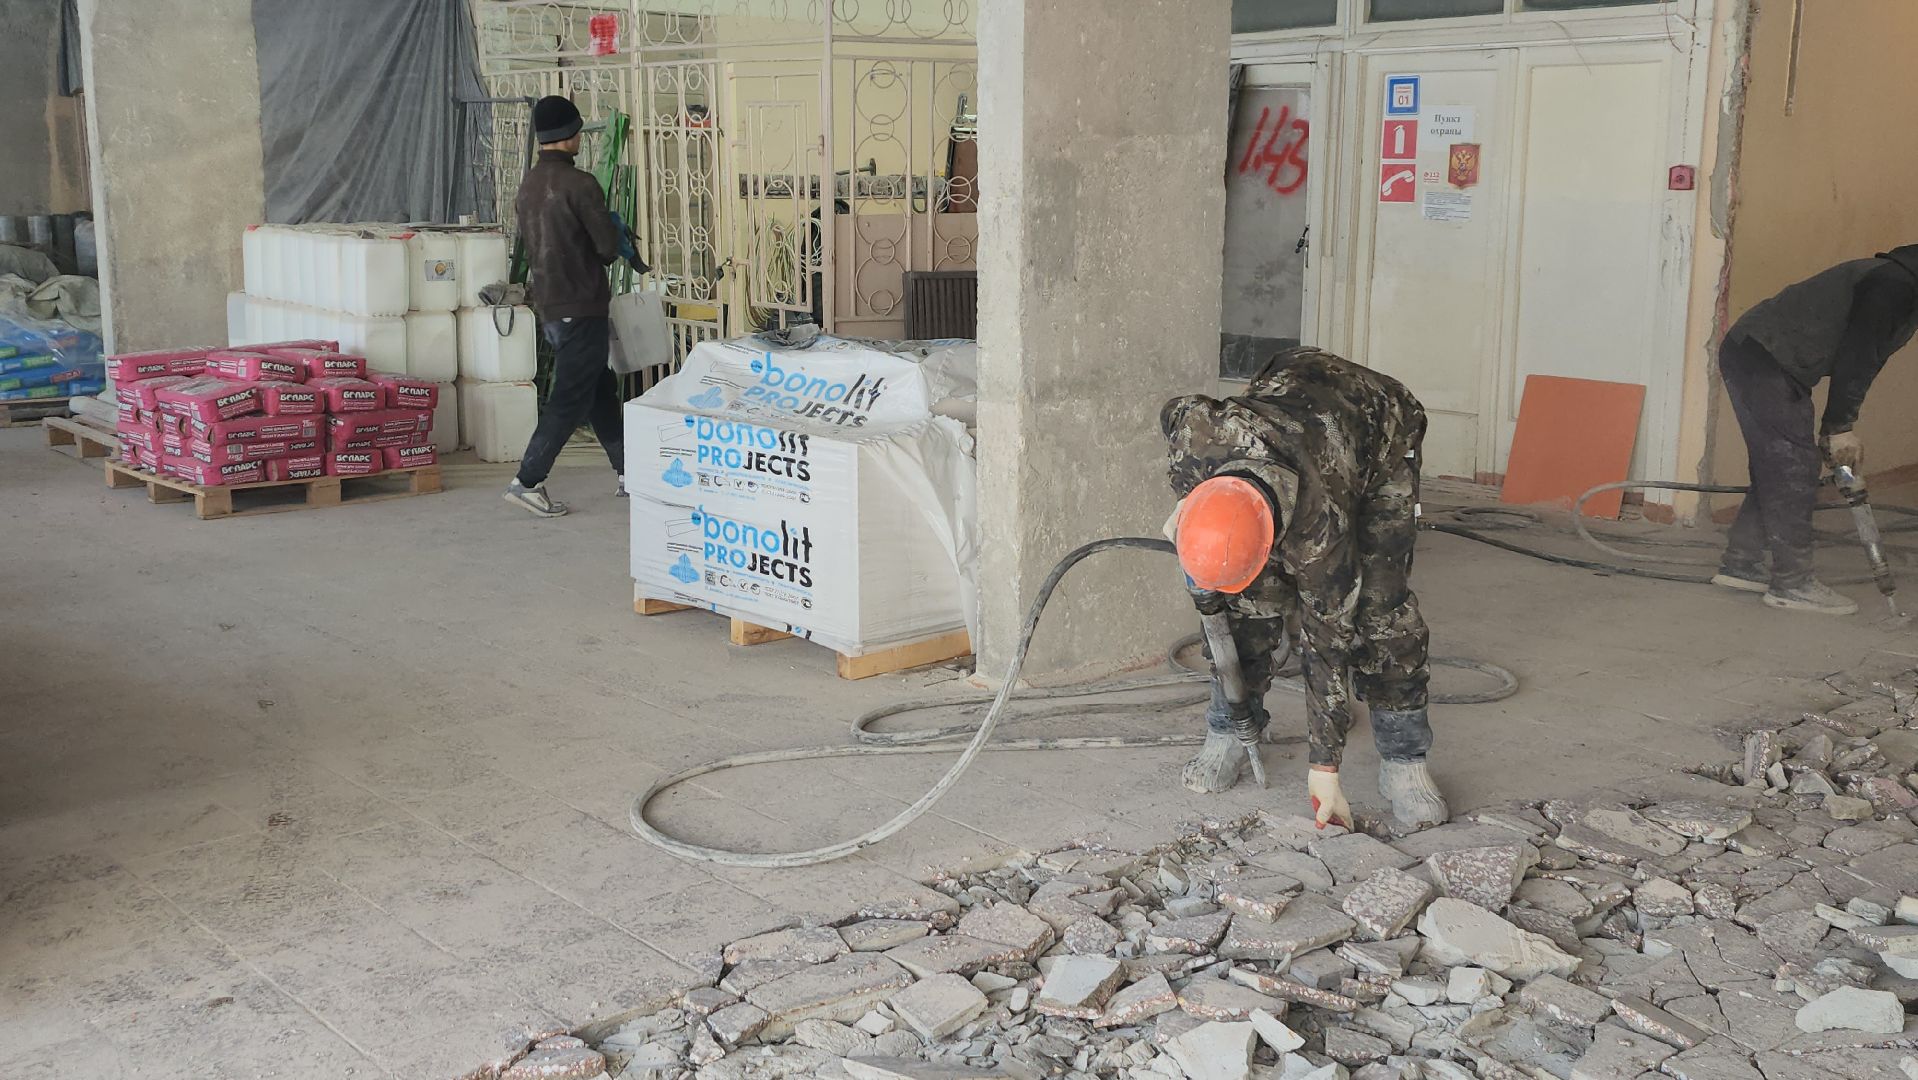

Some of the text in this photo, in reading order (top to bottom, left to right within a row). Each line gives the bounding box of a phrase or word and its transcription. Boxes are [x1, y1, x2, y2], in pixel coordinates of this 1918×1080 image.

[1434, 114, 1461, 124] Пункт
[760, 351, 885, 412] bonolit
[744, 385, 868, 428] PROJECTS
[697, 444, 811, 481] PROJECTS
[699, 503, 813, 563] bonolit
[703, 541, 813, 588] PROJECTS
